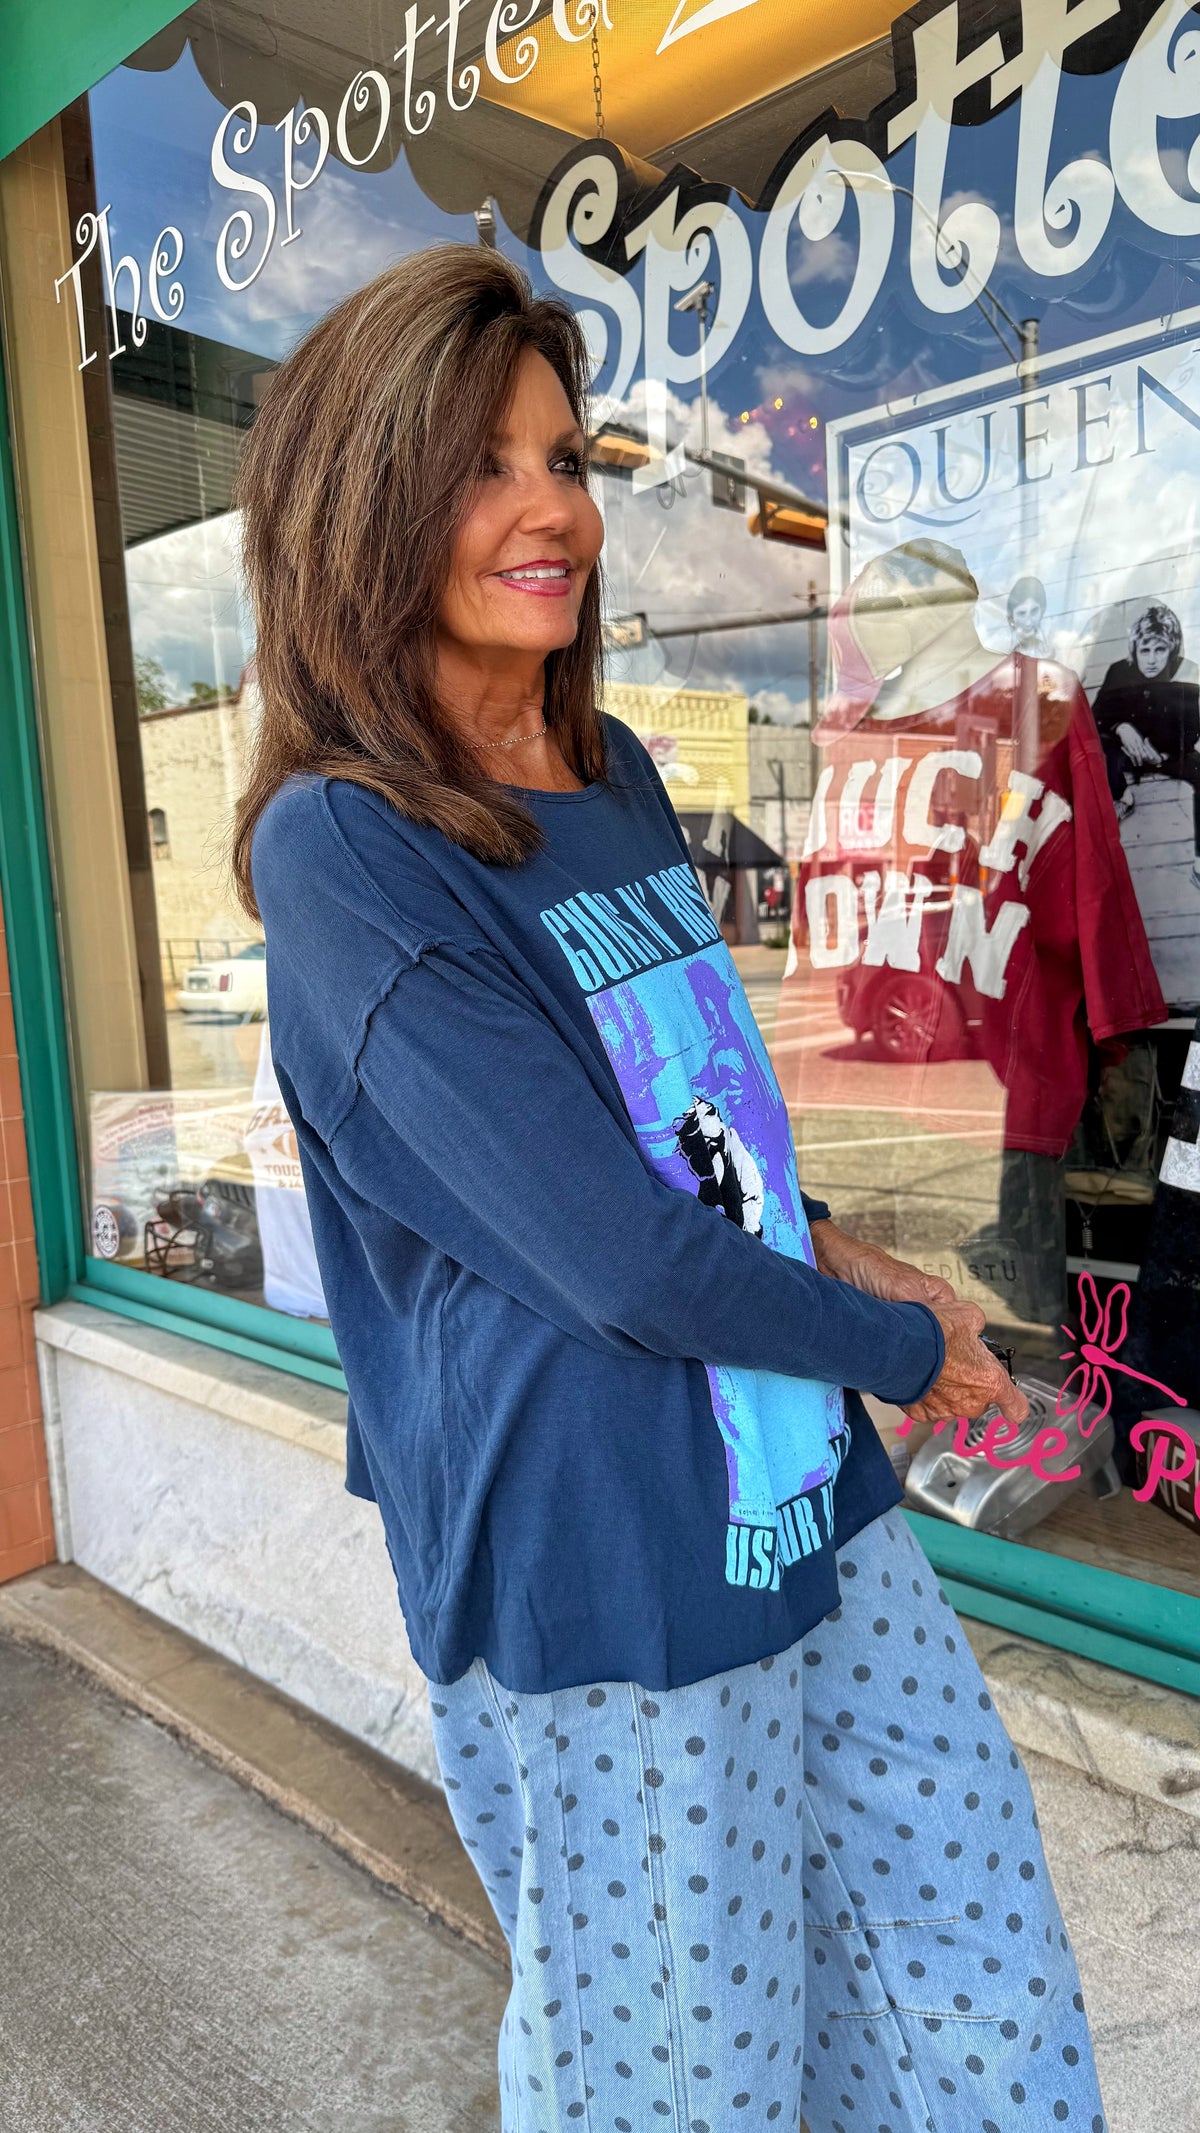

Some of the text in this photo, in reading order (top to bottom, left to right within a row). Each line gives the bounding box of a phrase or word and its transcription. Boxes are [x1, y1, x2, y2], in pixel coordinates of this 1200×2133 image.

[54, 204, 185, 372] The
[539, 890, 663, 992] GUNS
[783, 870, 1031, 1001] OWN
[264, 1164, 304, 1177] TOUC
[1129, 1418, 1200, 1519] P
[775, 1496, 822, 1567] UR
